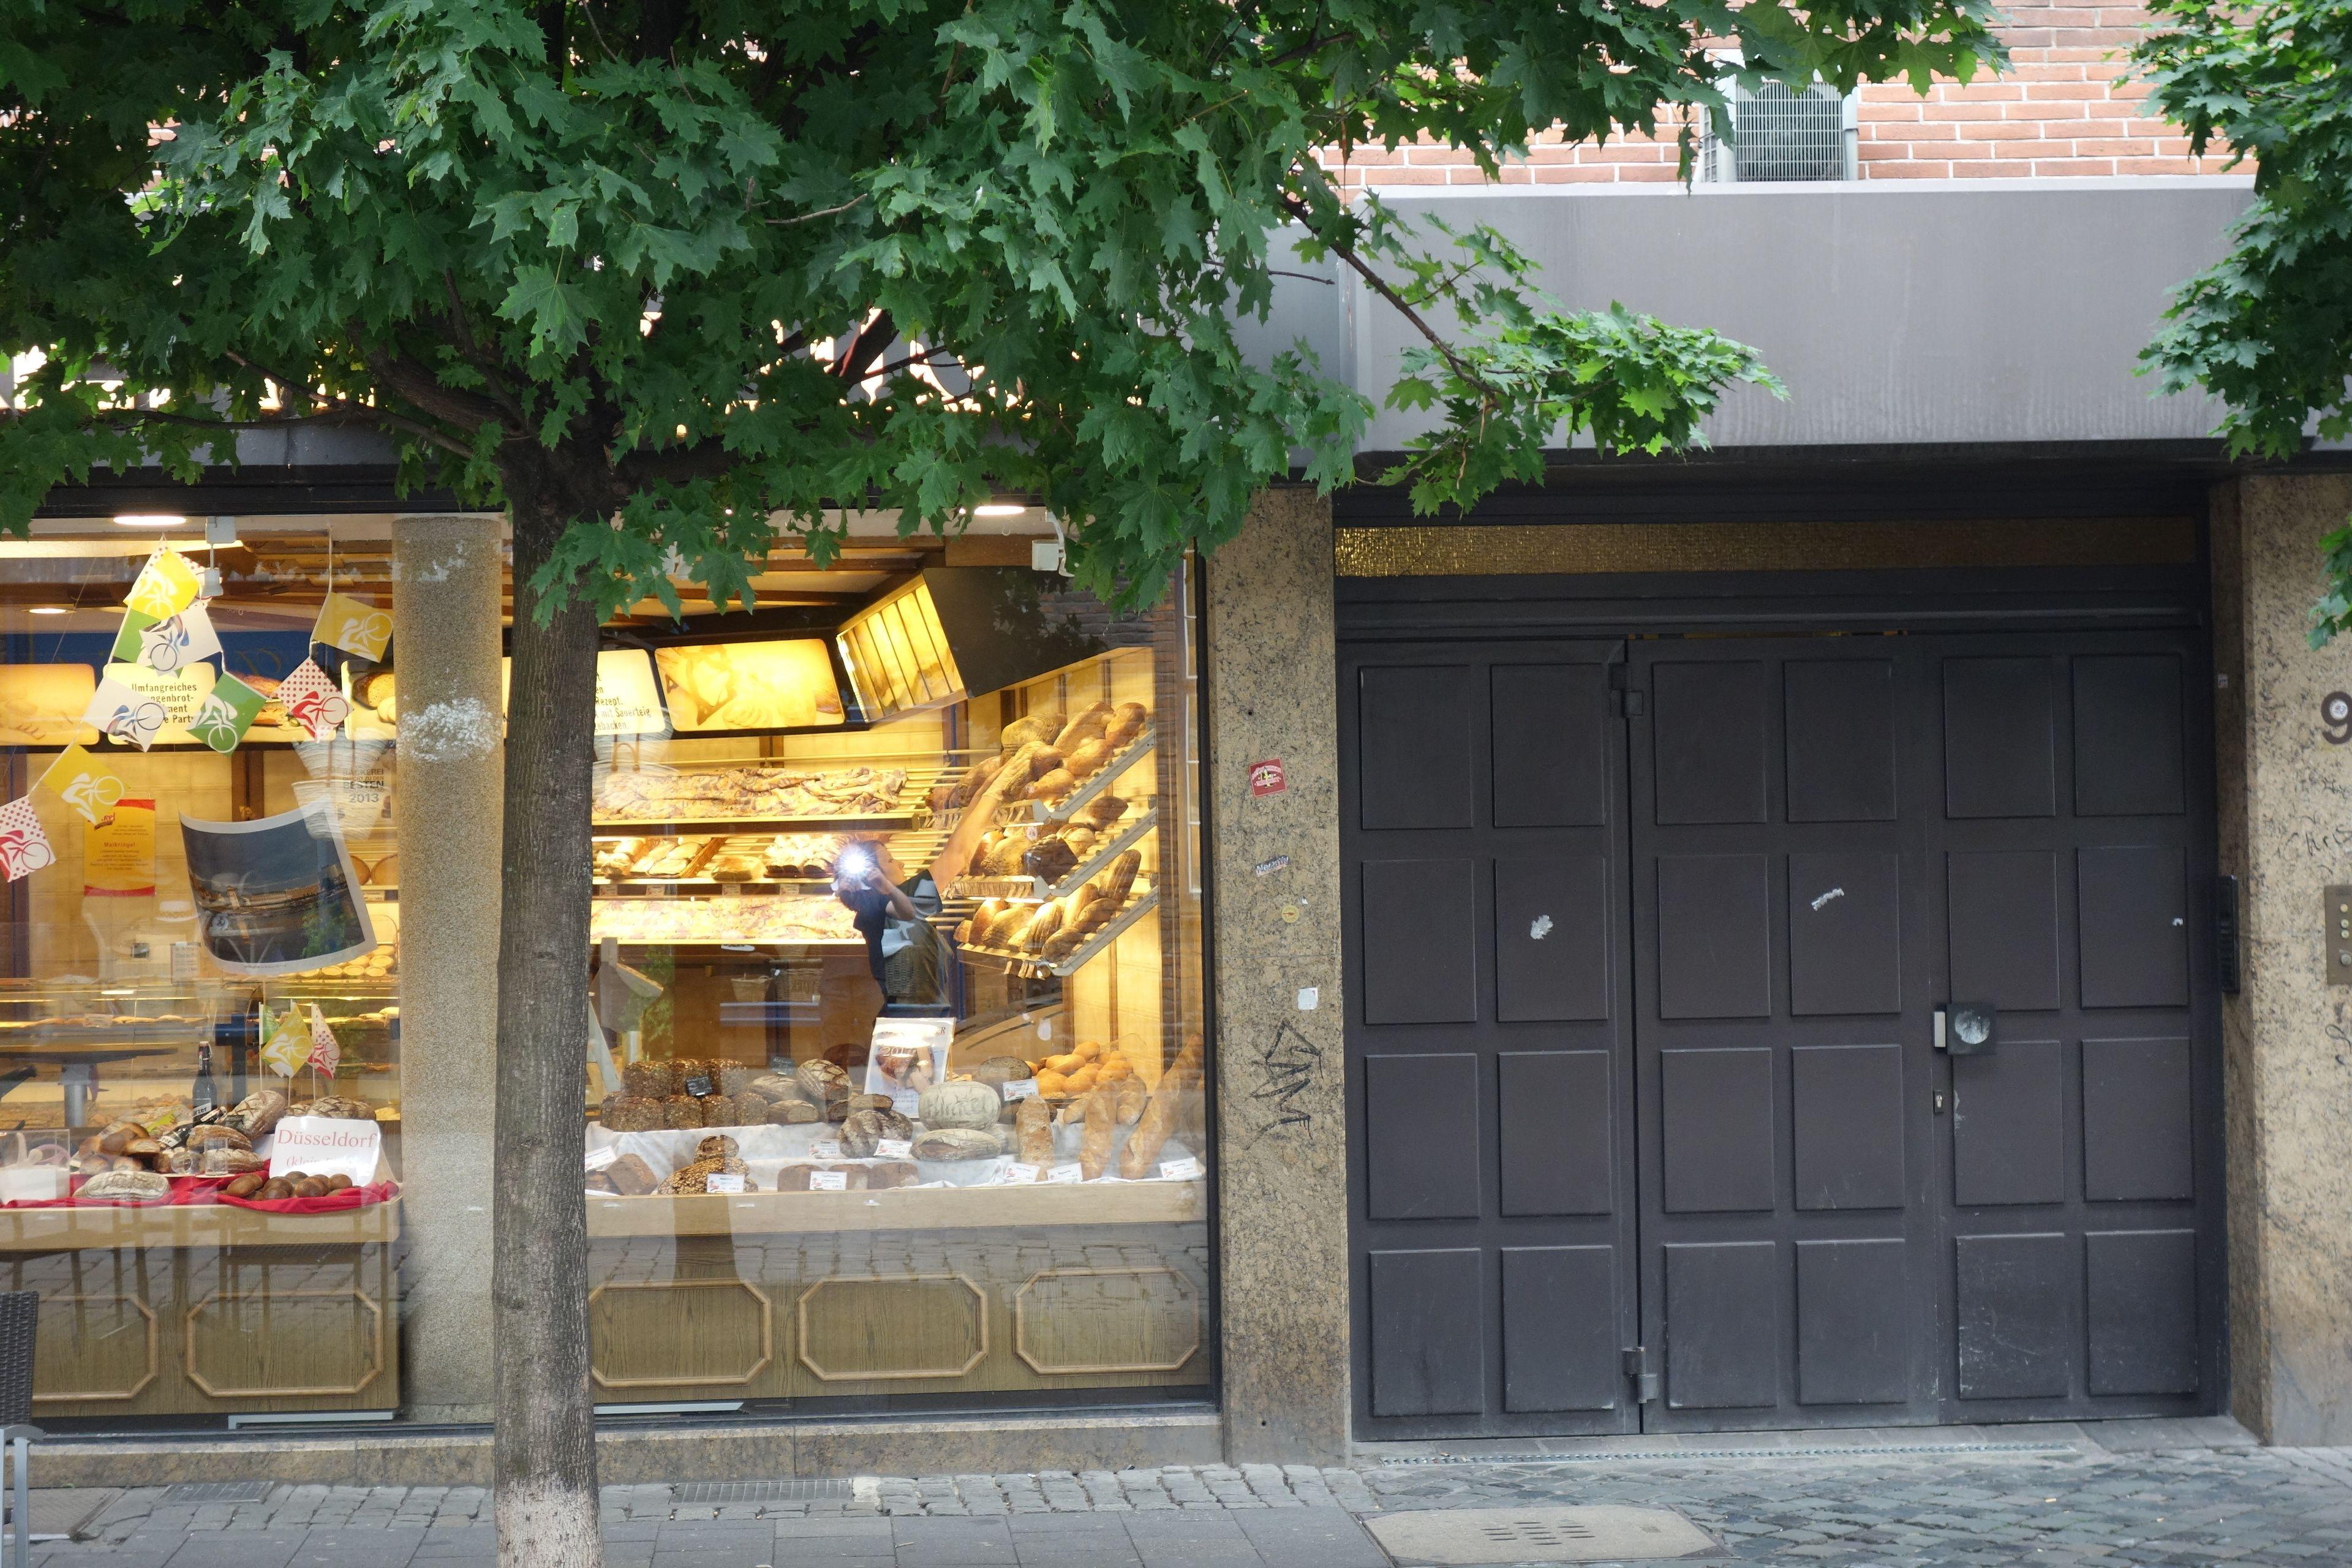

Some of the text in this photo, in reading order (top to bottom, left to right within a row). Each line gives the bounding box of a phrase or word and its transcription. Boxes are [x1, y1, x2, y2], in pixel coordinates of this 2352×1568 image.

[132, 683, 197, 693] Umfangreiches
[150, 693, 194, 703] ngenbrot-
[615, 706, 652, 718] Sauerteig
[2321, 691, 2352, 744] 9
[349, 793, 379, 803] 2013
[277, 1129, 377, 1148] Düsseldorf
